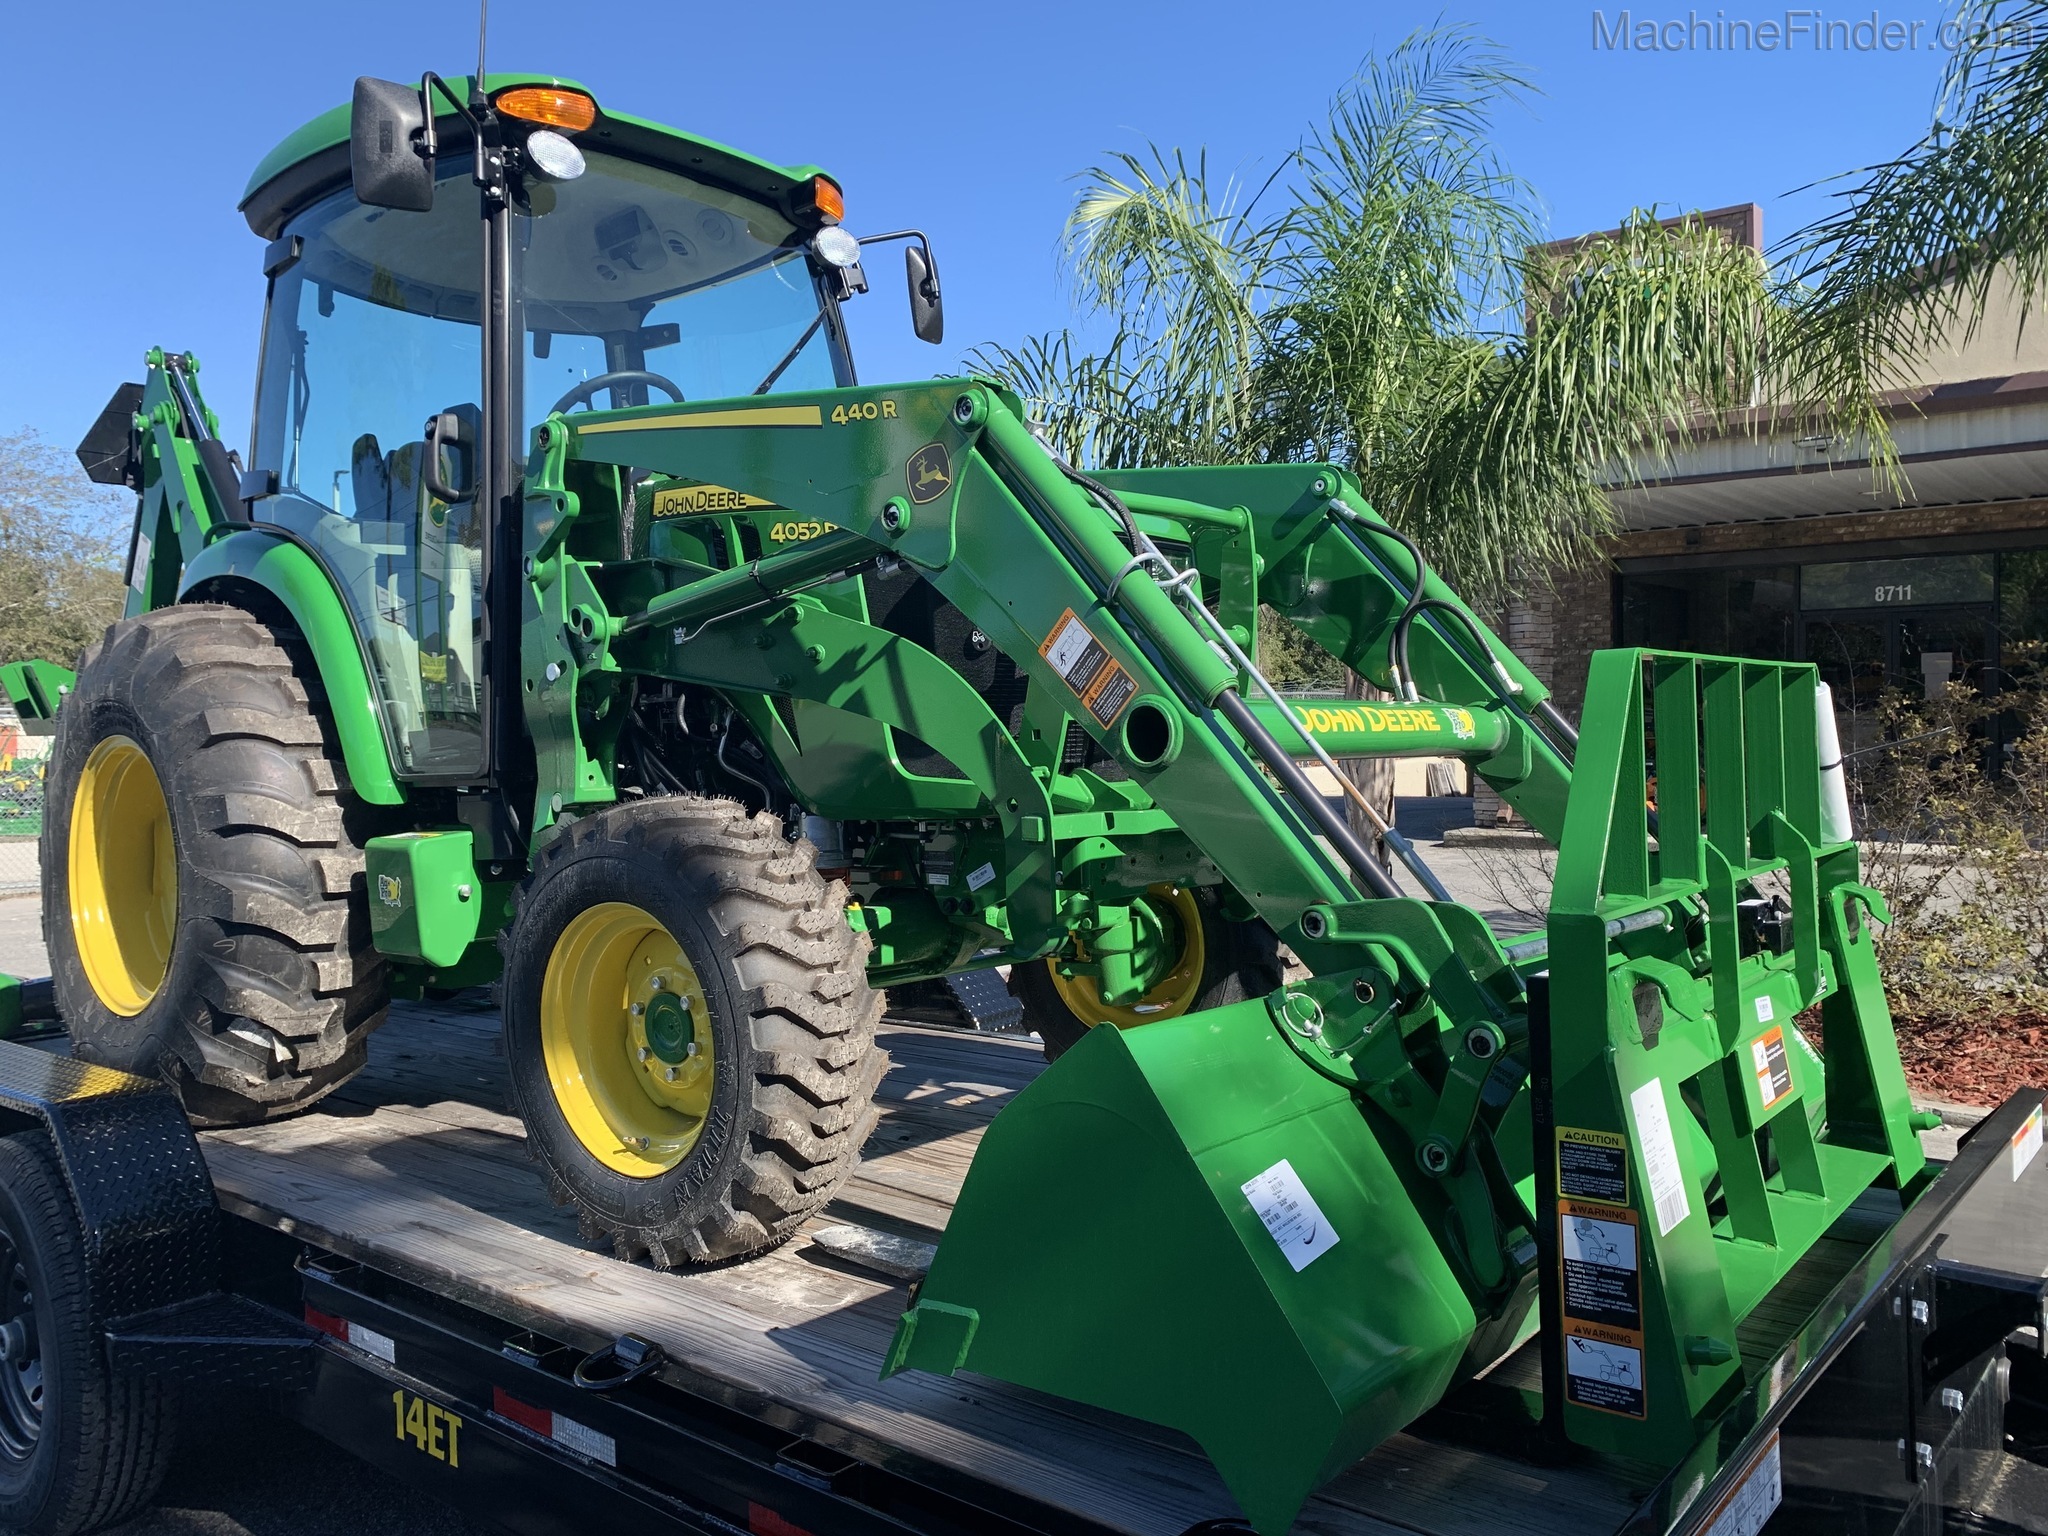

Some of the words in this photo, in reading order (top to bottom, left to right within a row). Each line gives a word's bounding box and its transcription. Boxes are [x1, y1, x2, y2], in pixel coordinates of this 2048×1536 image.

[657, 495, 694, 514] JOHN
[696, 491, 747, 510] DEERE
[1874, 584, 1912, 602] 8711
[1047, 614, 1070, 645] WARNING
[1092, 665, 1116, 696] WARNING
[1295, 706, 1366, 734] JOHN
[1357, 706, 1441, 732] DEERE
[1573, 1131, 1619, 1146] CAUTION
[1577, 1204, 1627, 1220] WARNING
[1582, 1327, 1632, 1344] WARNING
[392, 1389, 463, 1469] 14ET
